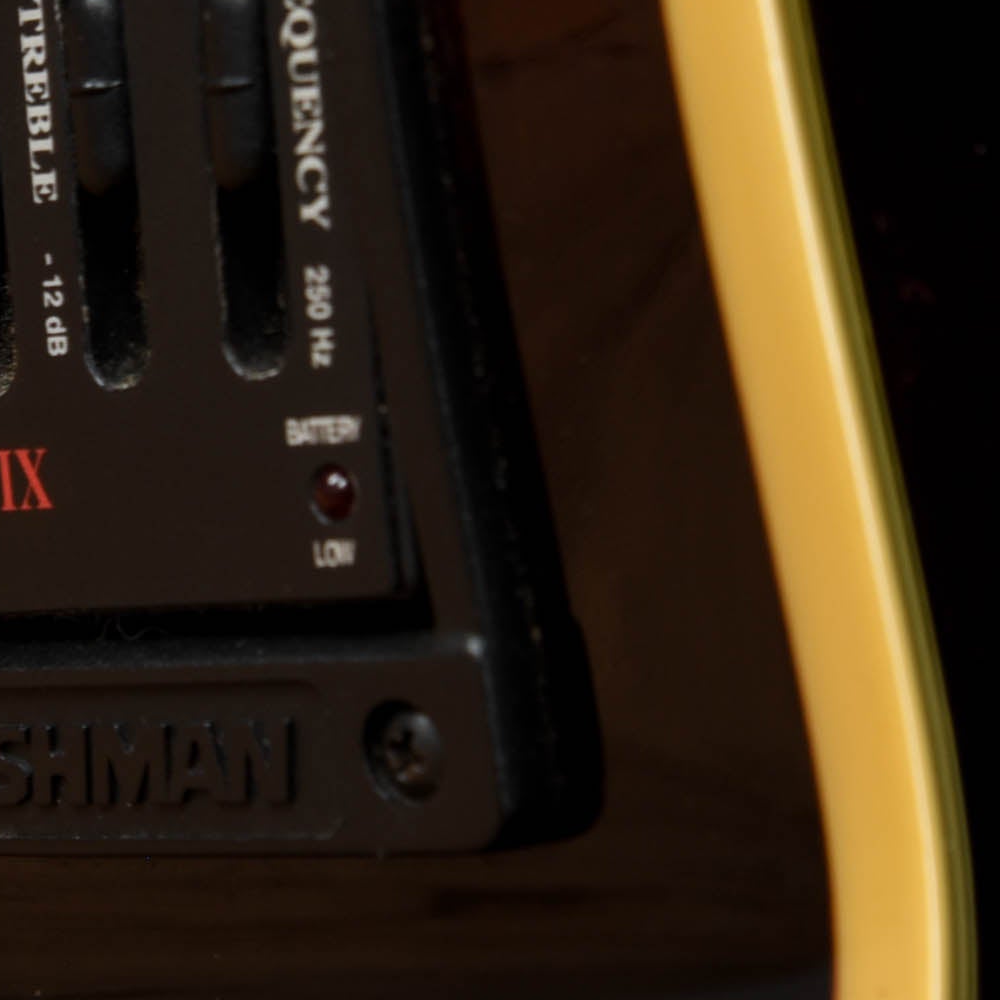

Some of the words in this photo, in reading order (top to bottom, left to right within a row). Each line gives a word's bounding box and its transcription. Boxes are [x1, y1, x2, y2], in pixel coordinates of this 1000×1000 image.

[303, 265, 333, 321] 250
[44, 315, 69, 357] dB
[309, 328, 335, 368] Hz
[285, 415, 361, 446] BATTERY
[313, 539, 356, 568] LOW
